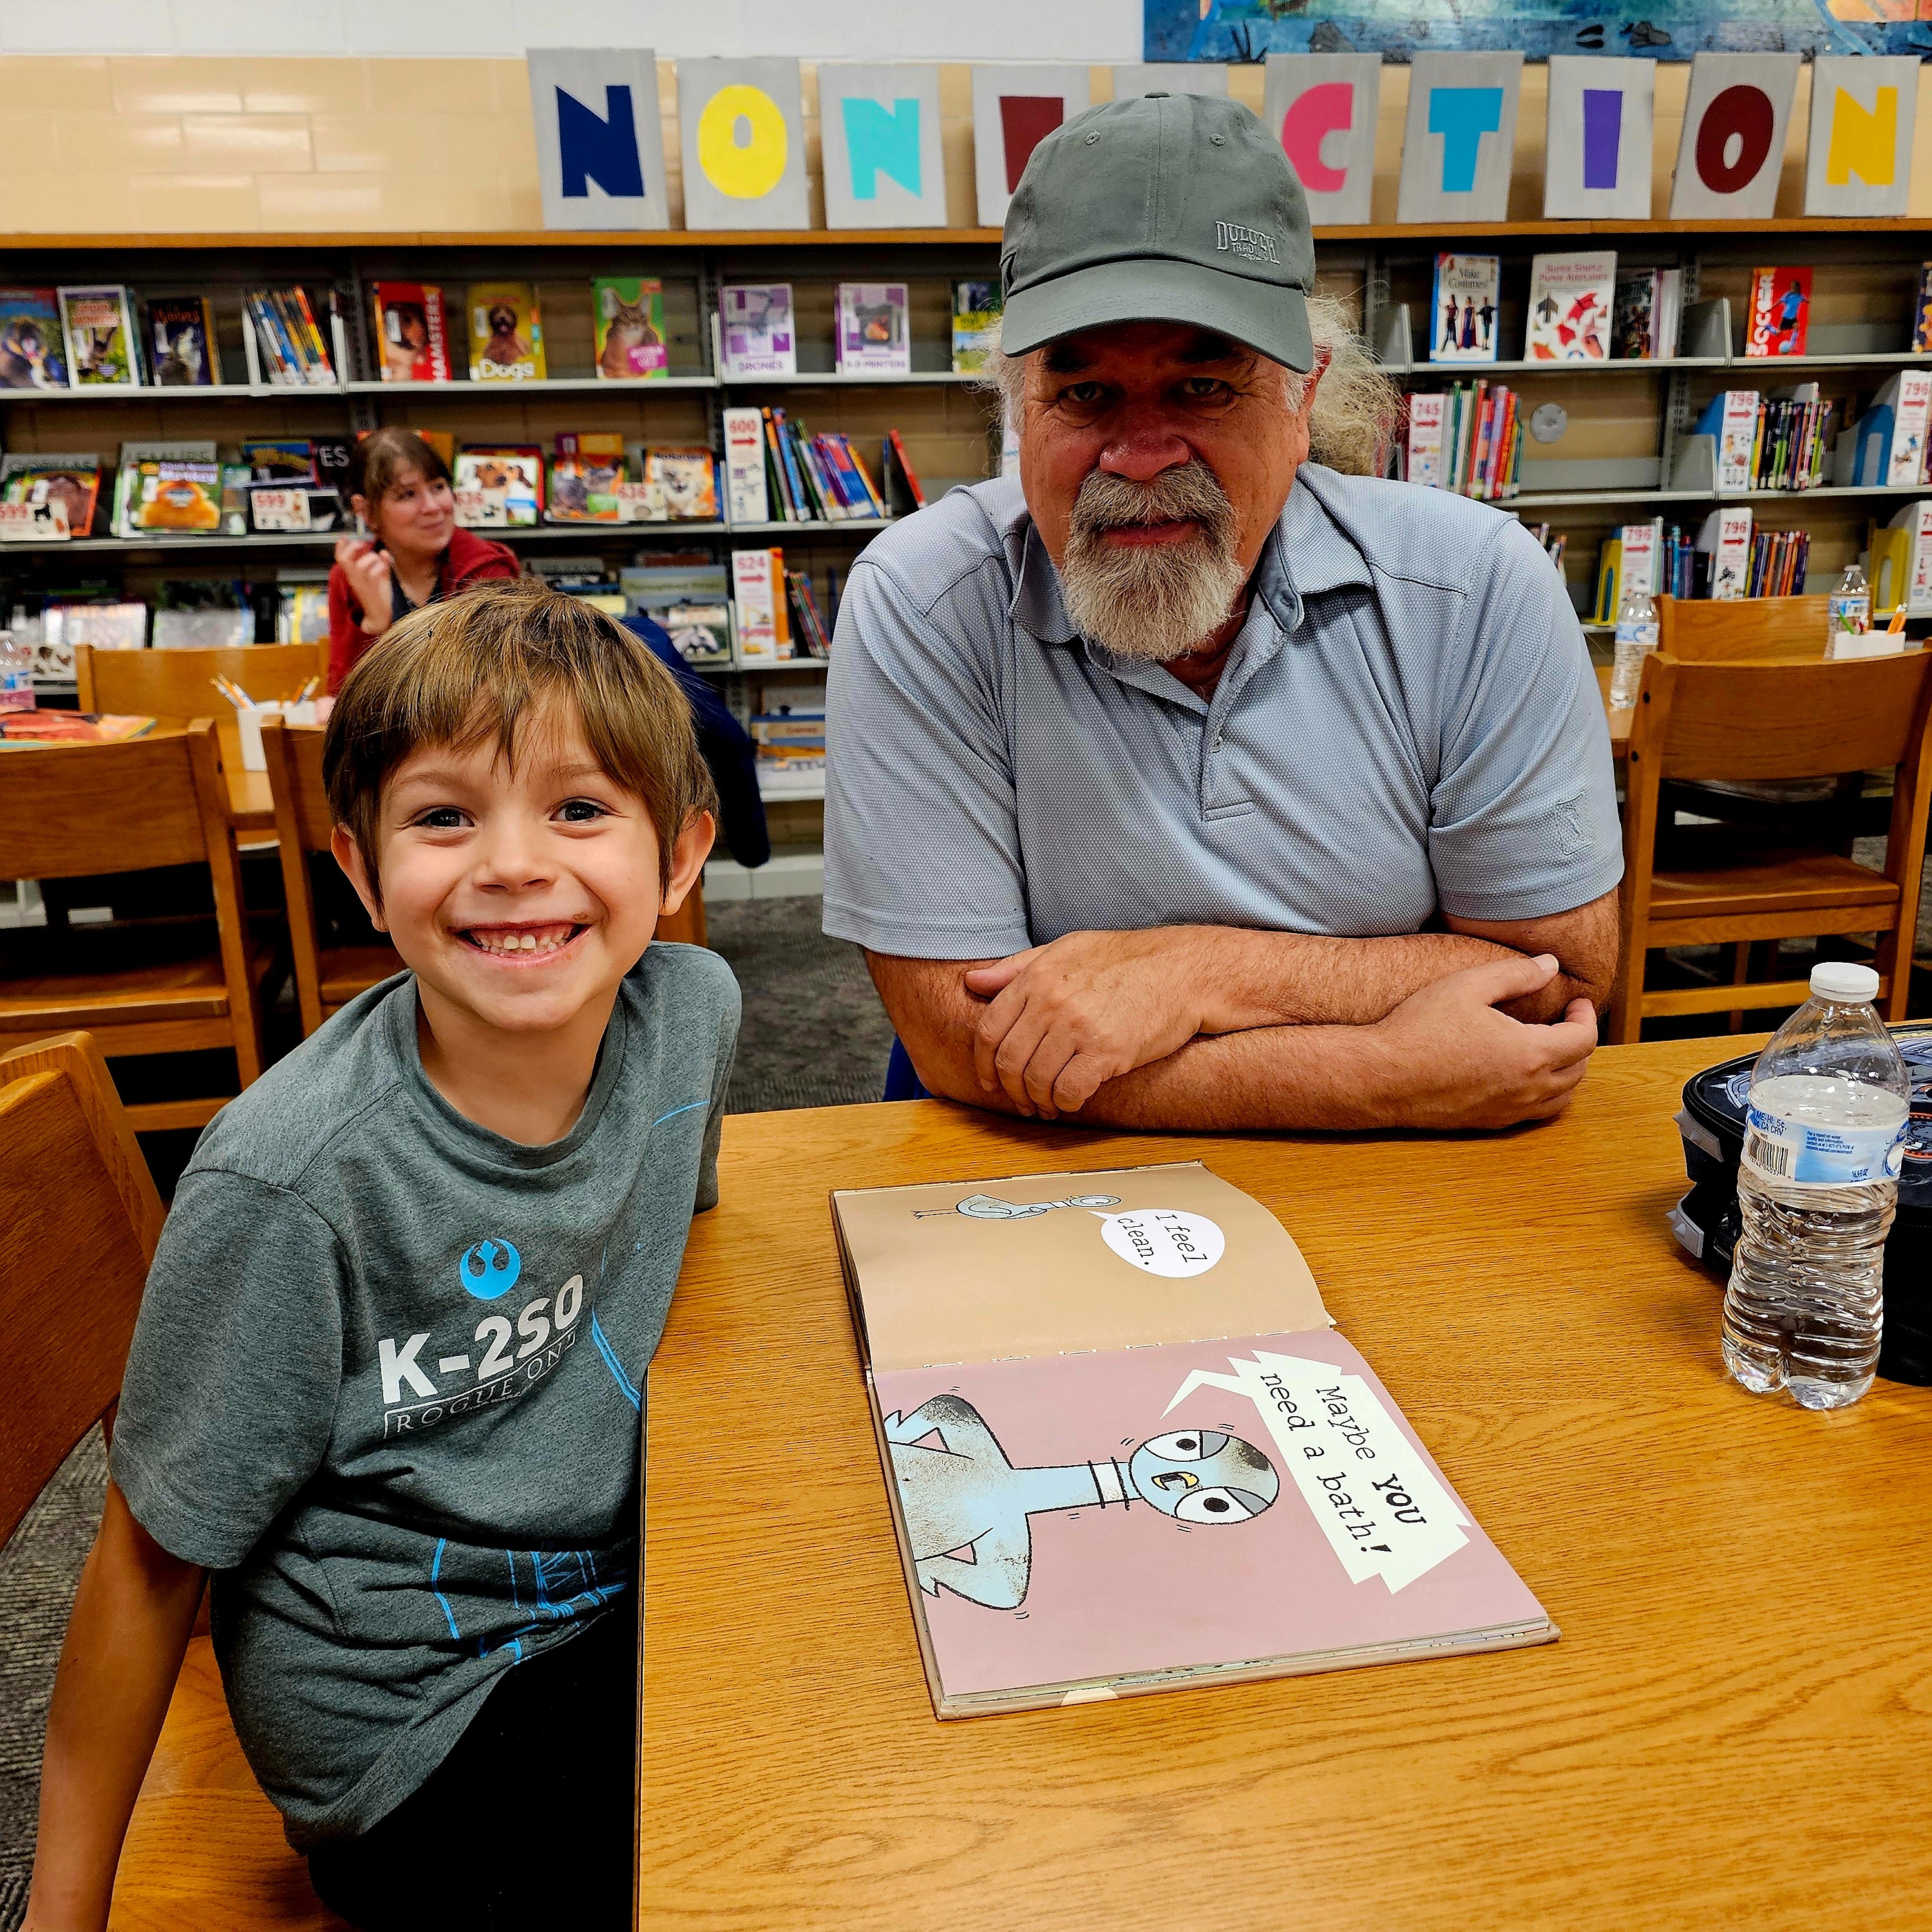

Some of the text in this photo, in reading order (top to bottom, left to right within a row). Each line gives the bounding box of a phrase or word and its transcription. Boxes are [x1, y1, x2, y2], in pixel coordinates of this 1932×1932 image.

[1216, 220, 1280, 265] DULUTH
[478, 358, 535, 382] Dogs
[738, 360, 784, 372] DRONES
[1730, 393, 1754, 406] 796
[1905, 382, 1929, 396] 796
[729, 420, 757, 434] 600
[1723, 520, 1748, 535] 796
[1770, 1124, 1784, 1136] CRV
[1117, 1218, 1155, 1265] clean.
[1164, 1226, 1208, 1263] feel
[396, 1377, 513, 1434] ROGUE
[1260, 1373, 1392, 1553] need a bath!
[1316, 1385, 1428, 1524] Maybe YOU
